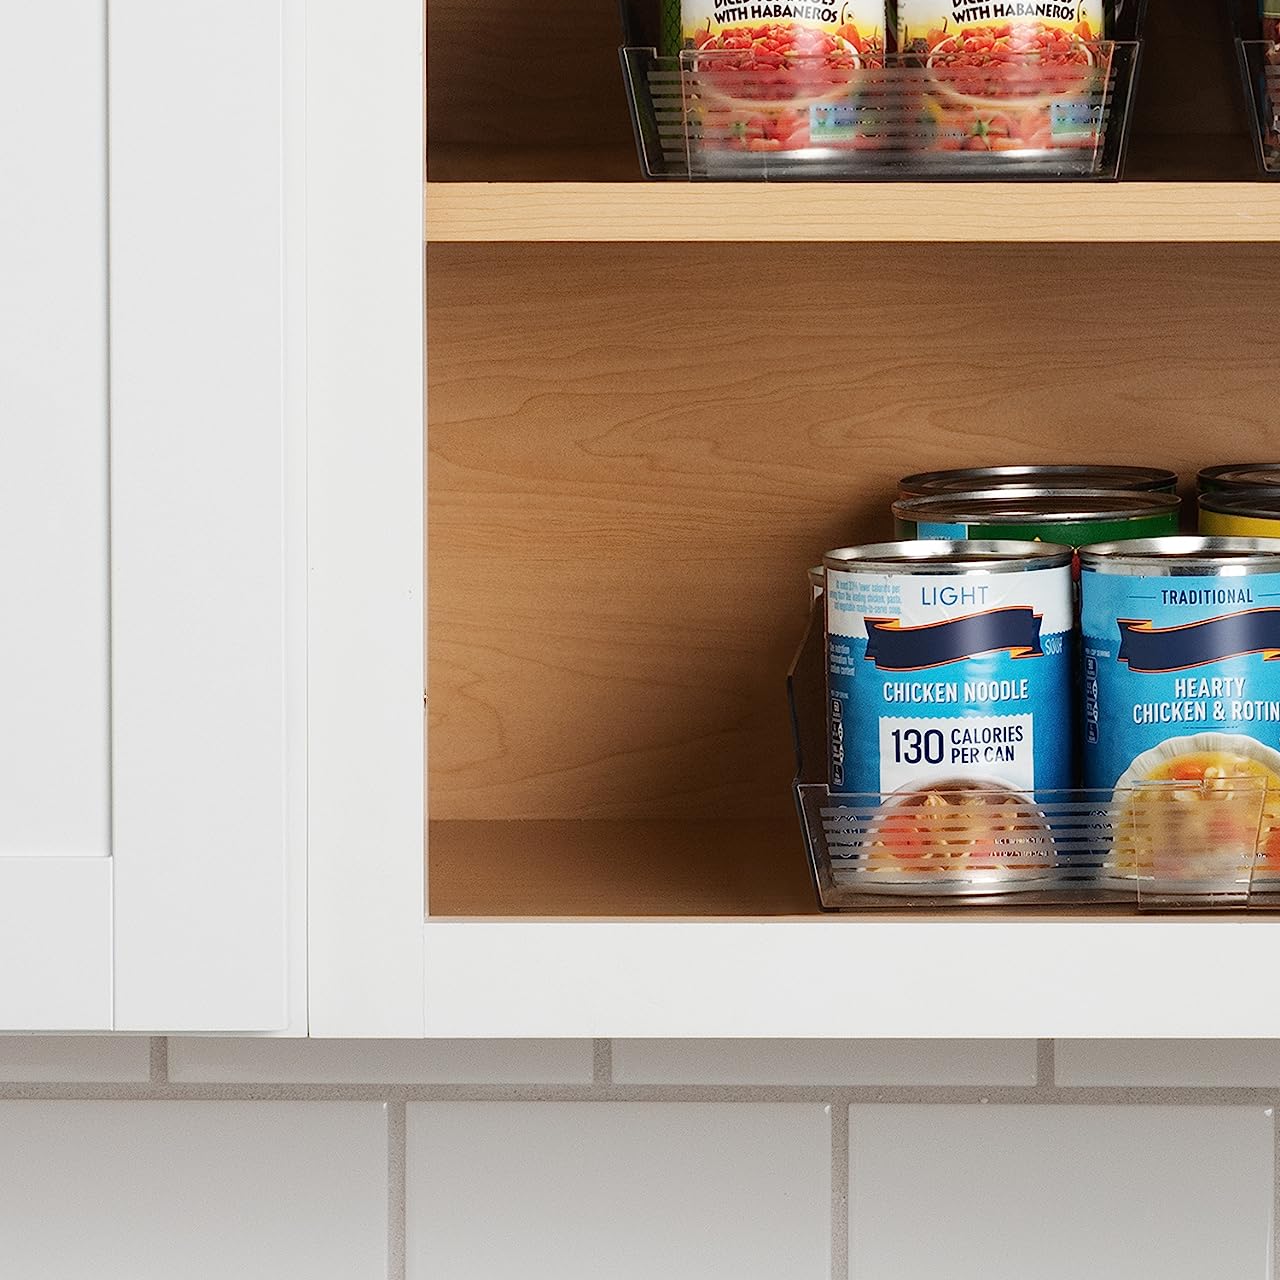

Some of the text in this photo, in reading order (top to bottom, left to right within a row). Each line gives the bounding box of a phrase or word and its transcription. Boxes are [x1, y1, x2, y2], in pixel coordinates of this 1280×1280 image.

[714, 5, 838, 24] WITH HABANEROS
[952, 3, 1075, 24] WITH HABANEROS
[921, 586, 989, 606] LIGHT
[1161, 588, 1254, 605] TRADITIONAL
[883, 679, 1029, 704] CHICKEN NOODLE
[1174, 677, 1246, 699] HEARTY
[1133, 701, 1206, 724] CHICKEN
[1212, 702, 1227, 722] &
[891, 726, 1024, 764] 130 CALORIES
[951, 745, 1015, 764] PER CAN
